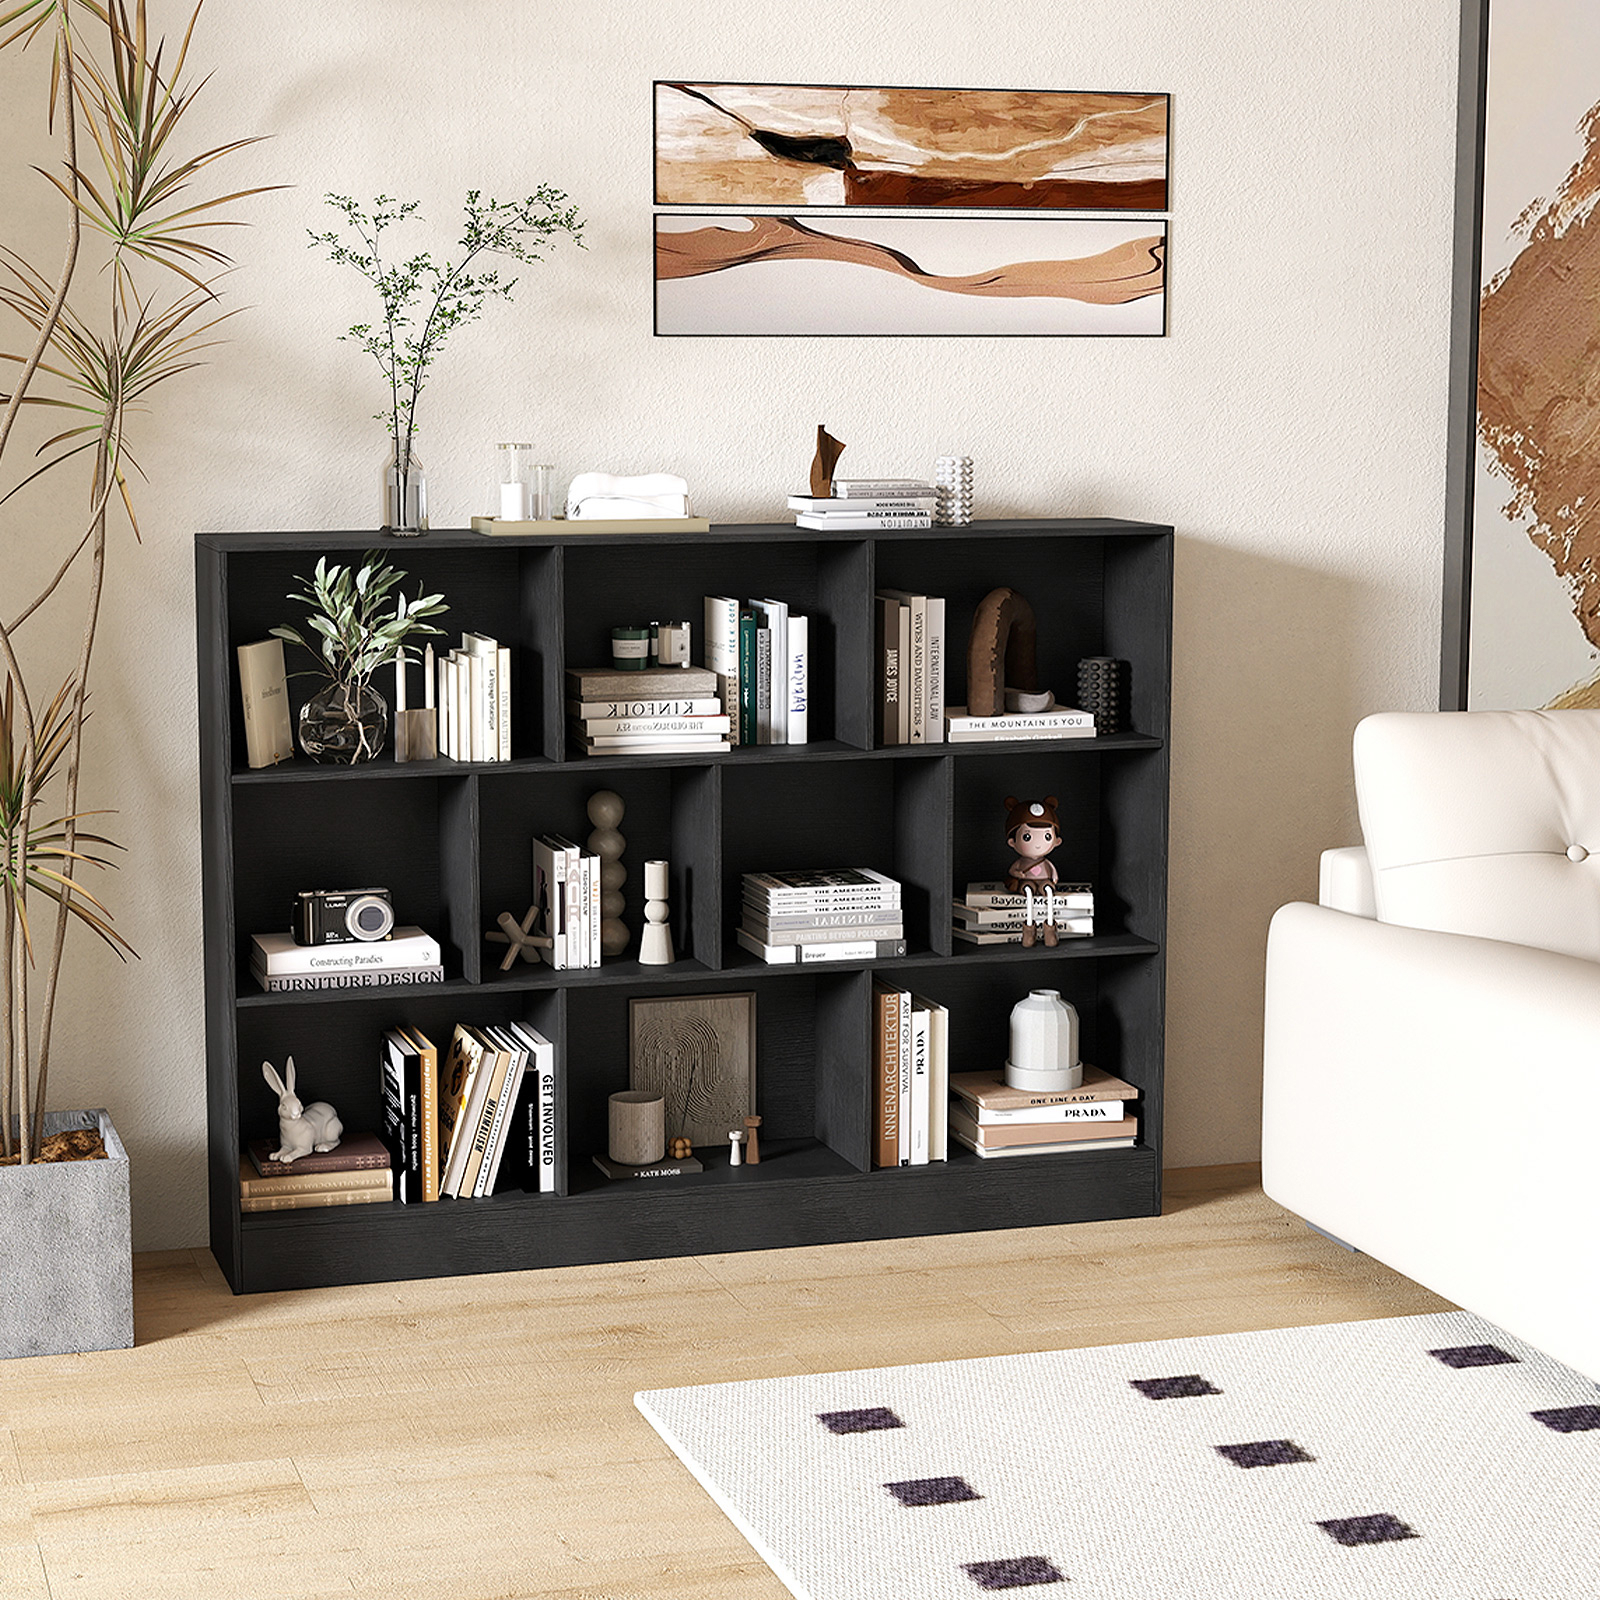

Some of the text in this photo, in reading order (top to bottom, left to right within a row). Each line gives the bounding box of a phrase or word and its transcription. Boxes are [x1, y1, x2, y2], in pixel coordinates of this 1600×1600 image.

[880, 519, 929, 528] INTUITION
[886, 649, 898, 703] JAMES JOYCE
[914, 612, 923, 725] WIVES AND DAUGHTERS
[930, 636, 939, 720] INTERNATIONAL LAW
[969, 717, 1083, 730] THE MOUNTAIN IS YOU
[833, 904, 881, 912] AMERICANS
[795, 931, 828, 942] PAINTING
[829, 930, 856, 940] BEYOND
[857, 928, 888, 938] POLLOCK
[310, 956, 353, 968] Constructing
[270, 970, 443, 991] FURNITURE DESIGN
[902, 1000, 910, 1020] ART
[902, 1023, 910, 1045] FOR
[916, 1030, 925, 1075] PRADA
[884, 994, 897, 1140] INNENARCHITEKTUR
[423, 1058, 431, 1099] simplicity
[543, 1075, 554, 1166] GET INVOLVED
[1065, 1108, 1106, 1117] PRADA
[474, 1098, 497, 1153] MINIMALISM
[424, 1122, 432, 1164] everything
[640, 1168, 681, 1178] KATE MOSS
